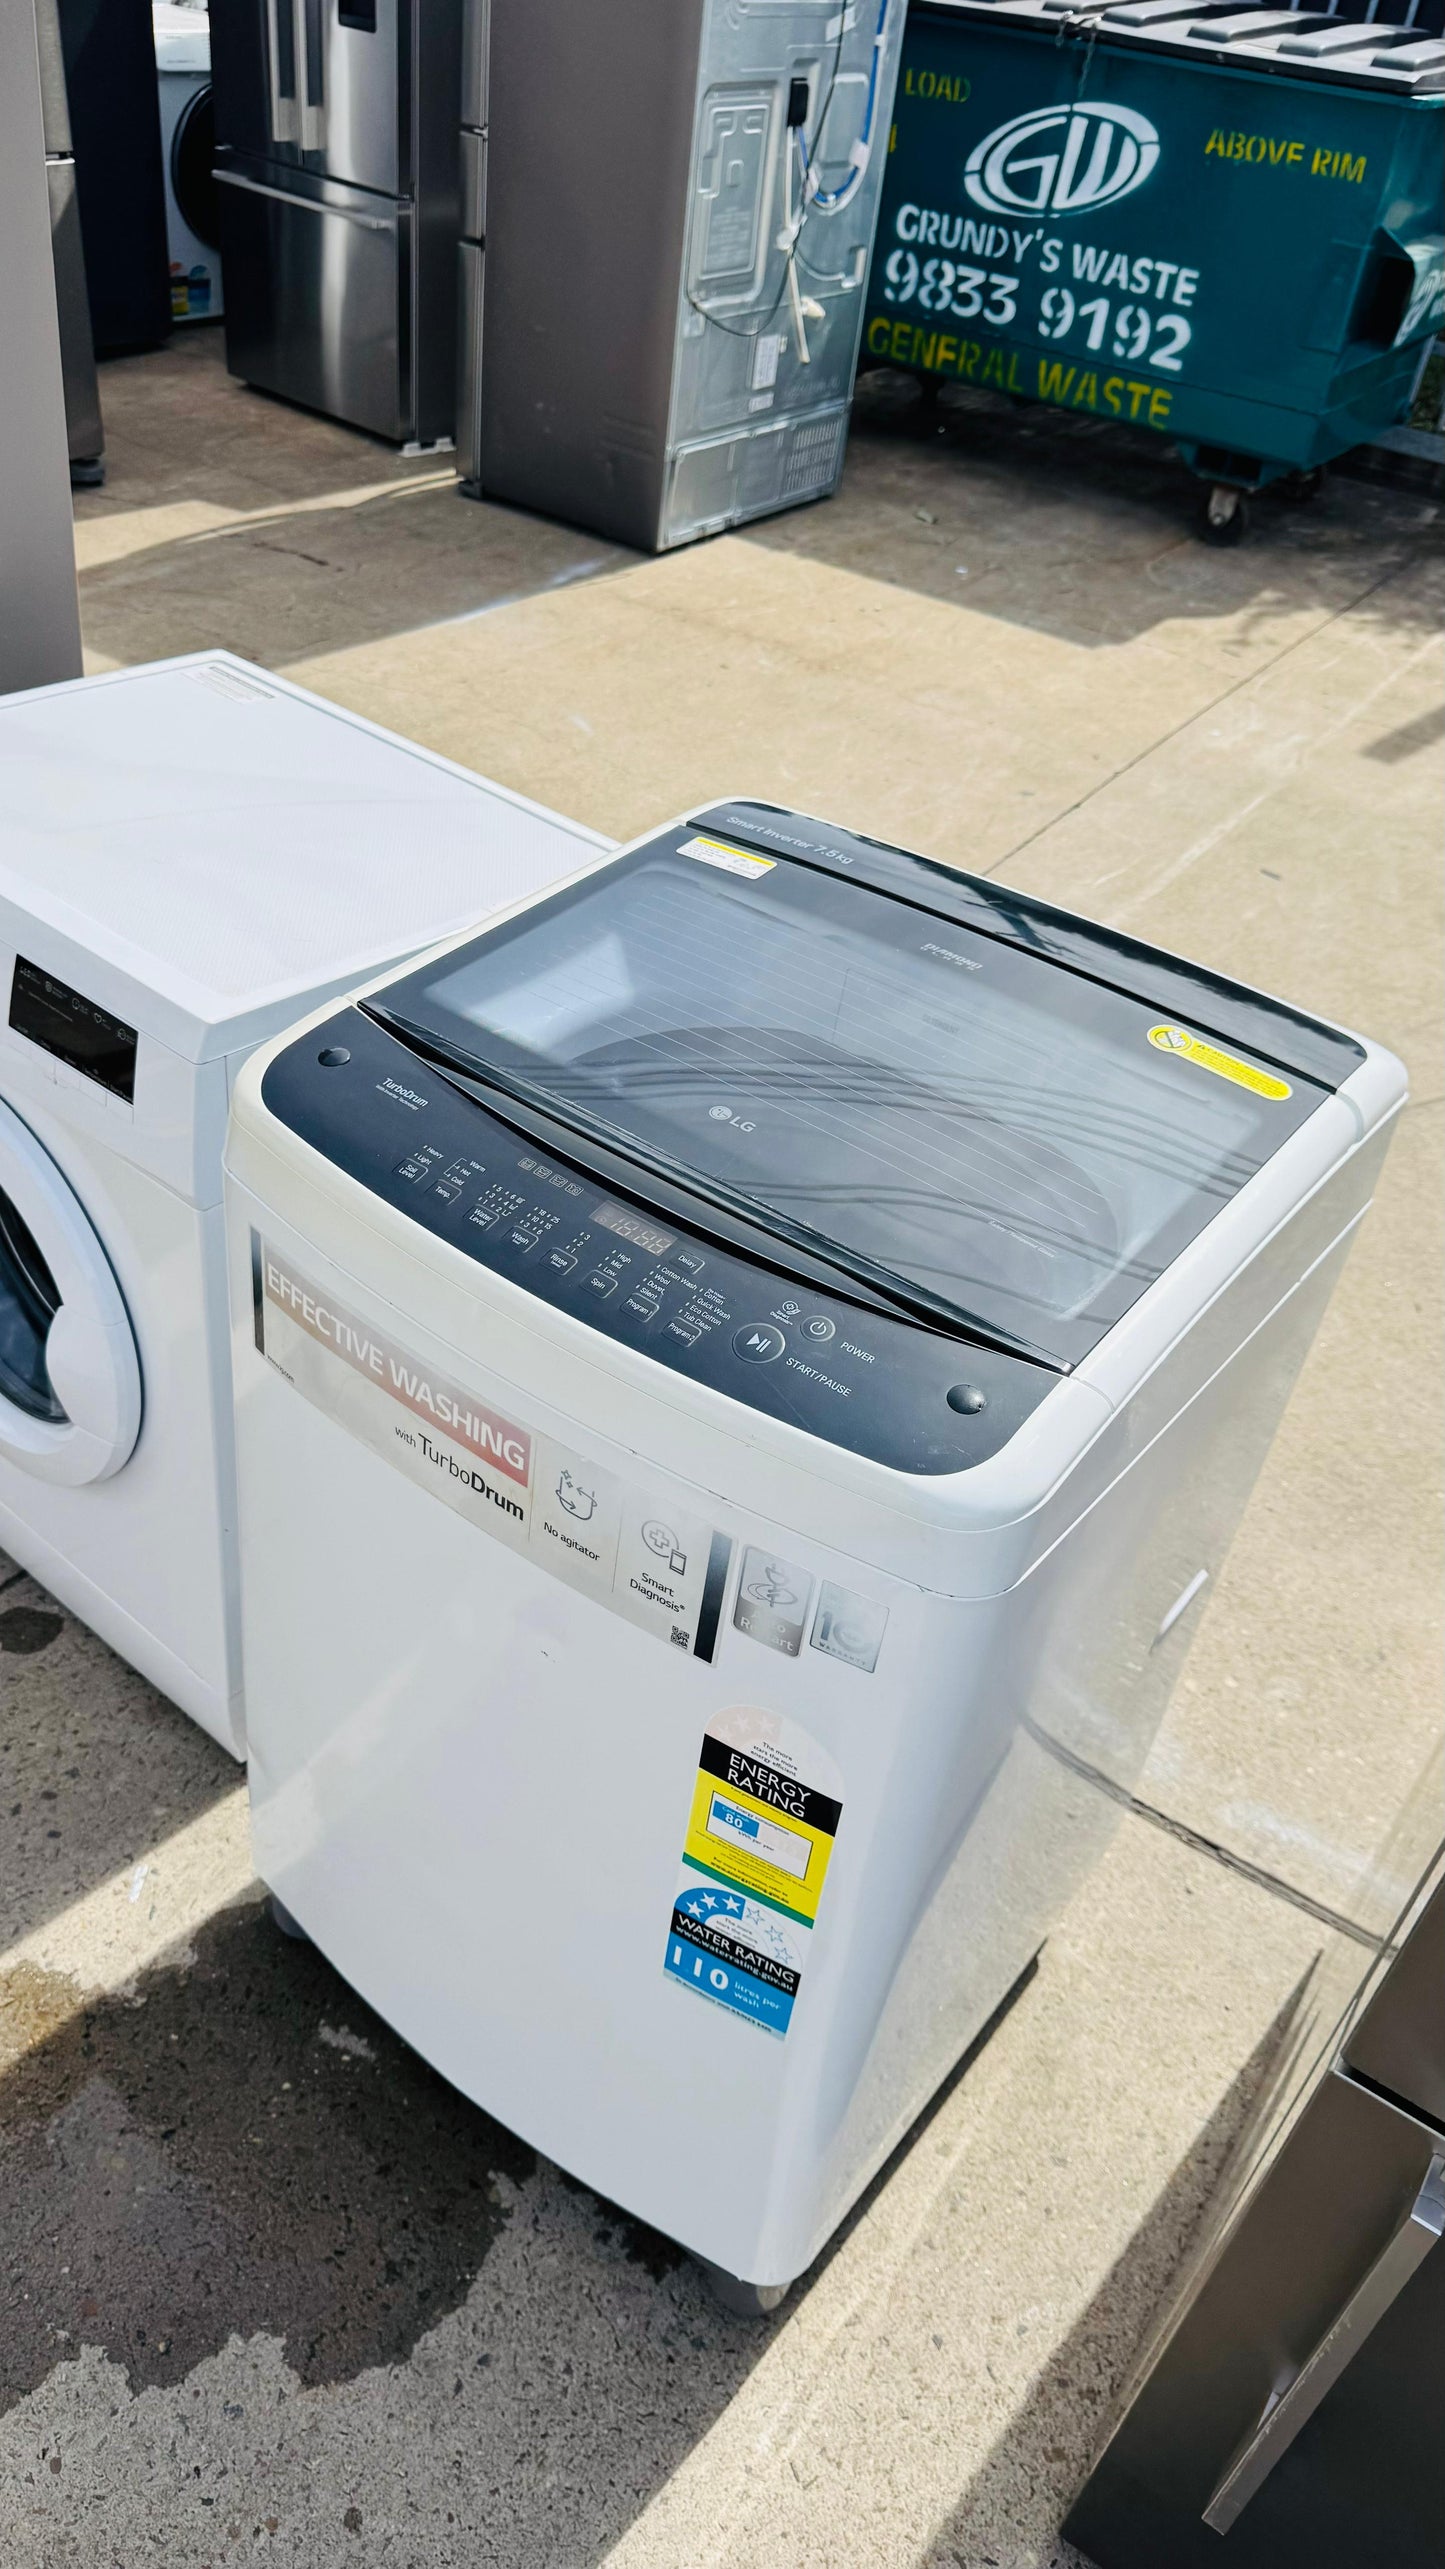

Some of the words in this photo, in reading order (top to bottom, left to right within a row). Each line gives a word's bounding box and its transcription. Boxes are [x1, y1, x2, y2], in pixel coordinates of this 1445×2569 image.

[905, 69, 971, 102] LOAD
[1204, 129, 1305, 166] ABOVE
[1310, 148, 1367, 184] RIM
[896, 204, 1063, 273] GRUNDY'S
[1072, 244, 1200, 307] WASTE
[884, 250, 1020, 325] 9833
[1038, 288, 1192, 372] 9192
[868, 317, 1023, 392] GENERAL
[1038, 359, 1173, 430] WASTE
[726, 816, 764, 833] Smart
[764, 828, 815, 848] Inverter
[382, 1077, 428, 1107] TurboDrum
[729, 1116, 756, 1132] LG
[417, 1154, 432, 1166] Light
[426, 1146, 444, 1160] Heavy
[398, 1167, 416, 1179] Level
[406, 1164, 419, 1174] Soil
[460, 1168, 472, 1177] Hot
[470, 1160, 486, 1173] Warm
[450, 1176, 465, 1186] Cold
[469, 1214, 487, 1227] Level
[474, 1208, 493, 1222] Water
[550, 1216, 560, 1224] 25
[544, 1222, 552, 1230] 15
[512, 1231, 530, 1245] Wash
[550, 1253, 568, 1267] Rinse
[610, 1260, 624, 1270] Mid
[617, 1252, 632, 1264] High
[678, 1254, 697, 1269] Delay
[603, 1266, 618, 1277] Low
[654, 1273, 671, 1286] Wool
[661, 1266, 681, 1282] Cotton
[680, 1277, 698, 1290] Wash
[590, 1277, 606, 1290] Spin
[646, 1280, 666, 1294] Duvet
[640, 1287, 658, 1300] Silent
[704, 1291, 724, 1306] Cotton
[626, 1298, 649, 1315] Program
[690, 1304, 702, 1315] Eco
[701, 1312, 722, 1326] Cotton
[696, 1298, 714, 1311] Quick
[714, 1307, 731, 1320] Wash
[684, 1311, 695, 1322] Tub
[694, 1318, 712, 1332] Clean
[668, 1322, 691, 1339] Program
[840, 1341, 876, 1364] POWER
[268, 1262, 384, 1376] EFFECTIVE
[389, 1358, 525, 1472] WASHING
[786, 1357, 852, 1398] START/PAUSE
[395, 1426, 416, 1448] with
[418, 1432, 525, 1521] TurboDrum
[544, 1522, 559, 1537] No
[560, 1533, 600, 1563] agitator
[641, 1572, 675, 1598] Smart
[763, 1742, 774, 1751] The
[729, 1752, 812, 1804] ENERGY
[727, 1768, 806, 1818] RATING
[724, 1812, 743, 1829] 80
[678, 1914, 730, 1952] WATER
[735, 1941, 795, 1984] RATING
[676, 1925, 794, 1992] www.waterrating.gov.au
[672, 1945, 729, 1990] 110
[734, 1981, 760, 2000] litres
[762, 1997, 781, 2010] per
[734, 1991, 760, 2008] wash
